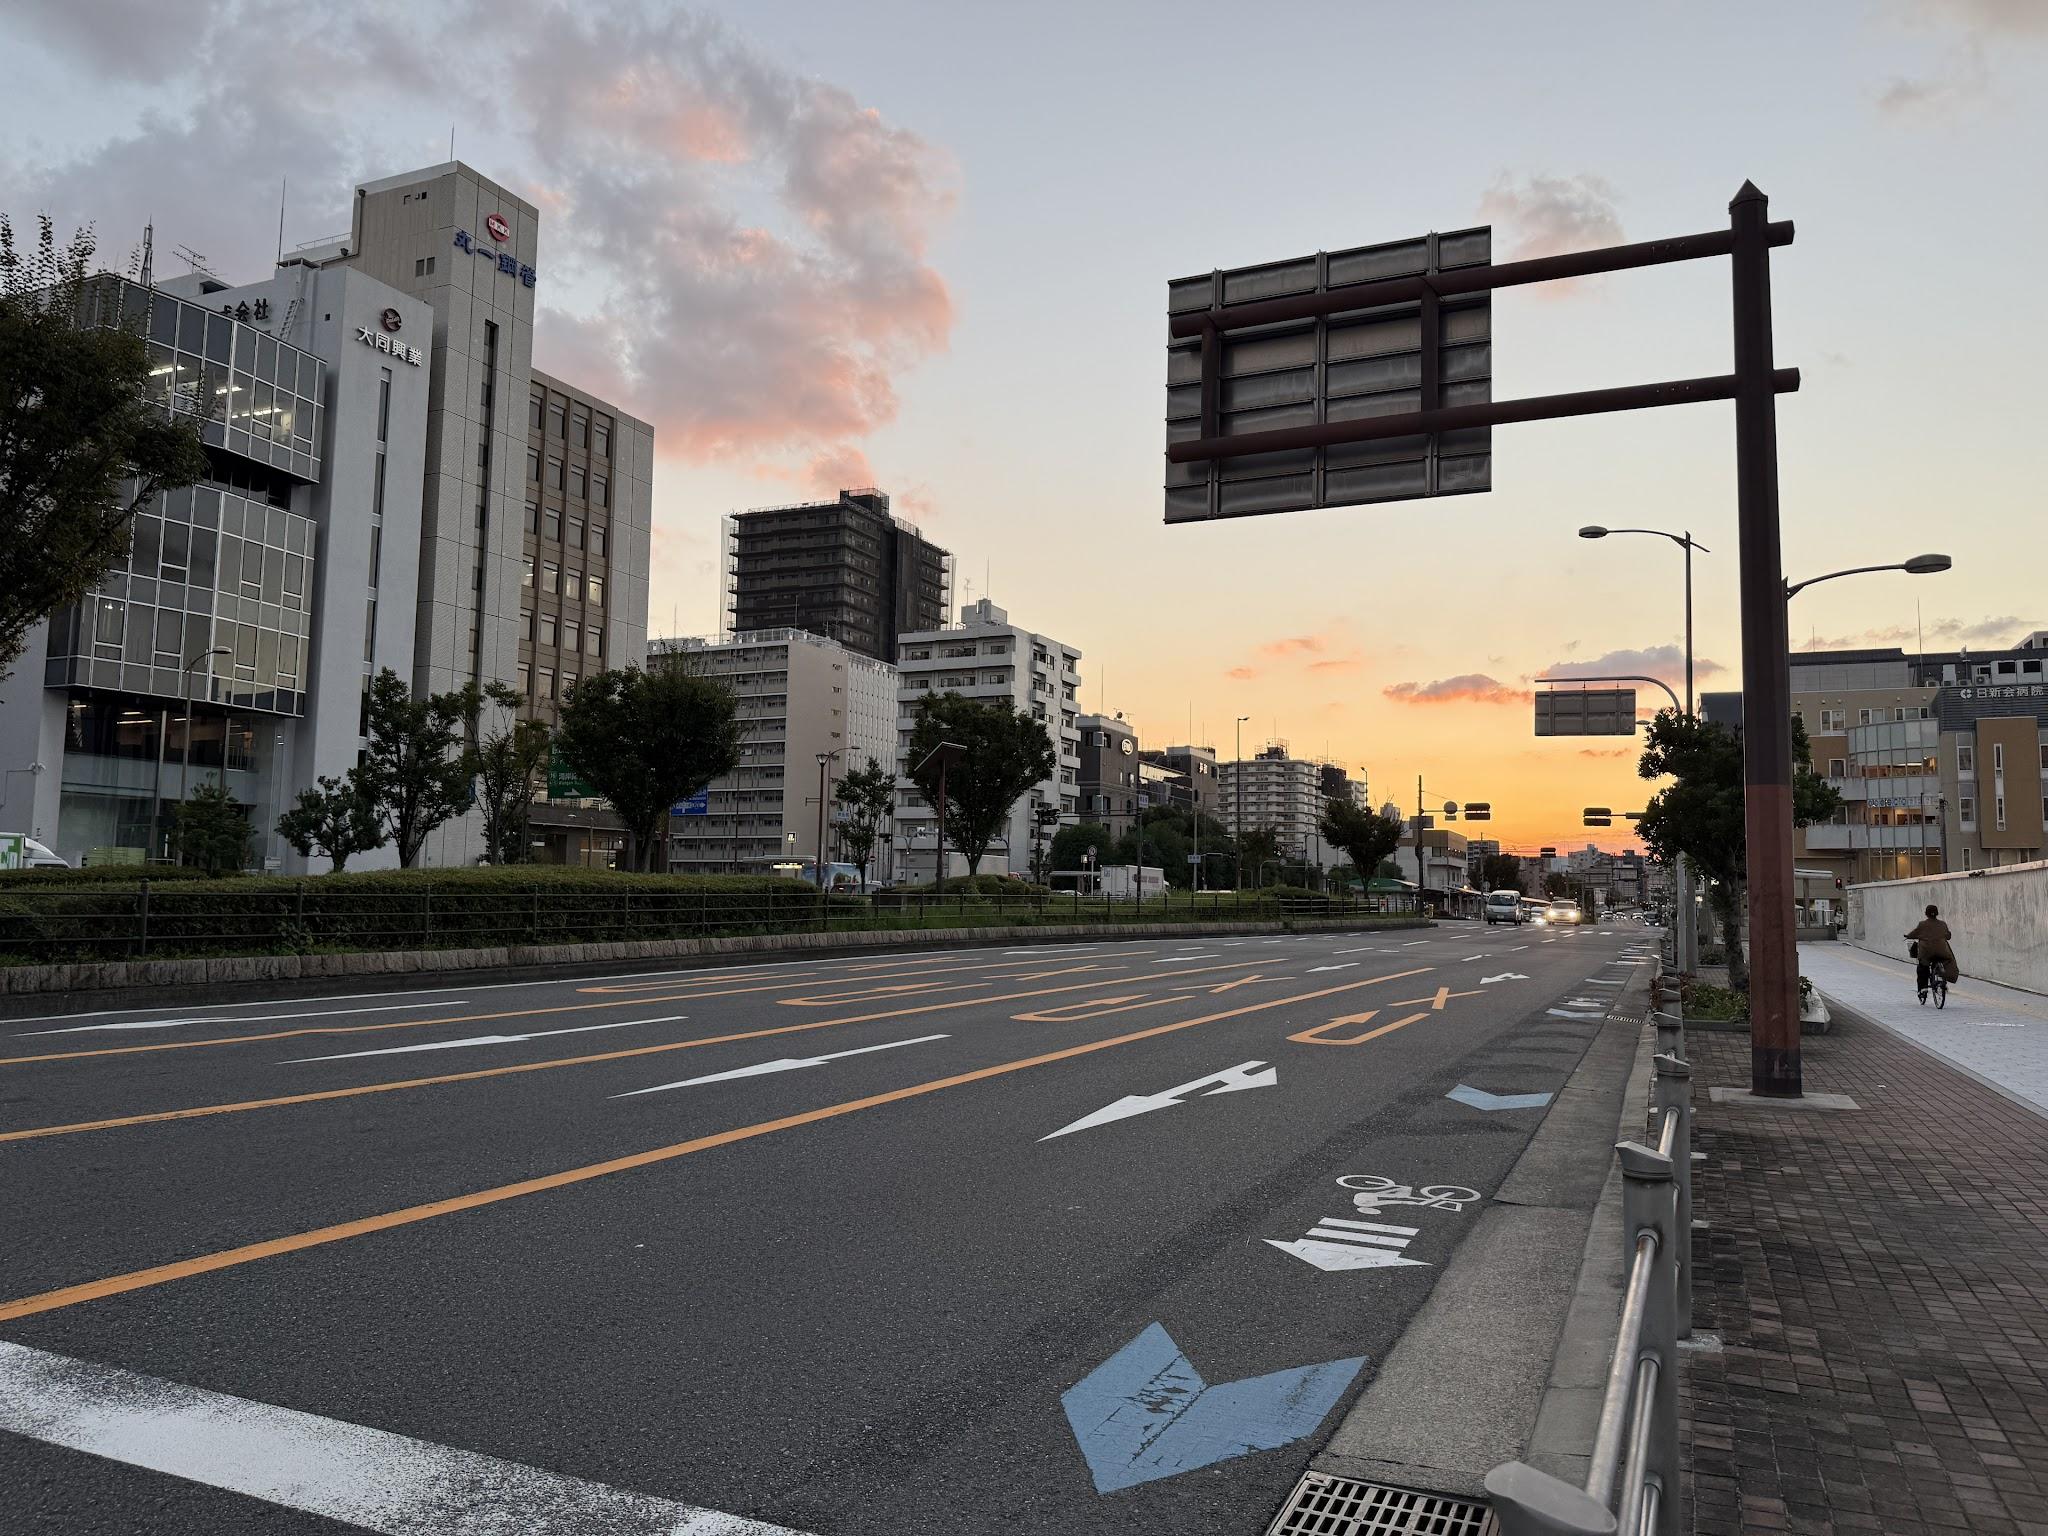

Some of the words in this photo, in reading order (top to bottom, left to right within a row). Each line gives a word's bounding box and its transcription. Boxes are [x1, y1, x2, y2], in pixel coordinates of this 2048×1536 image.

[454, 230, 537, 288] 丸一鋼管
[358, 326, 423, 367] 大同興業
[1977, 686, 2044, 698] 日新会病院
